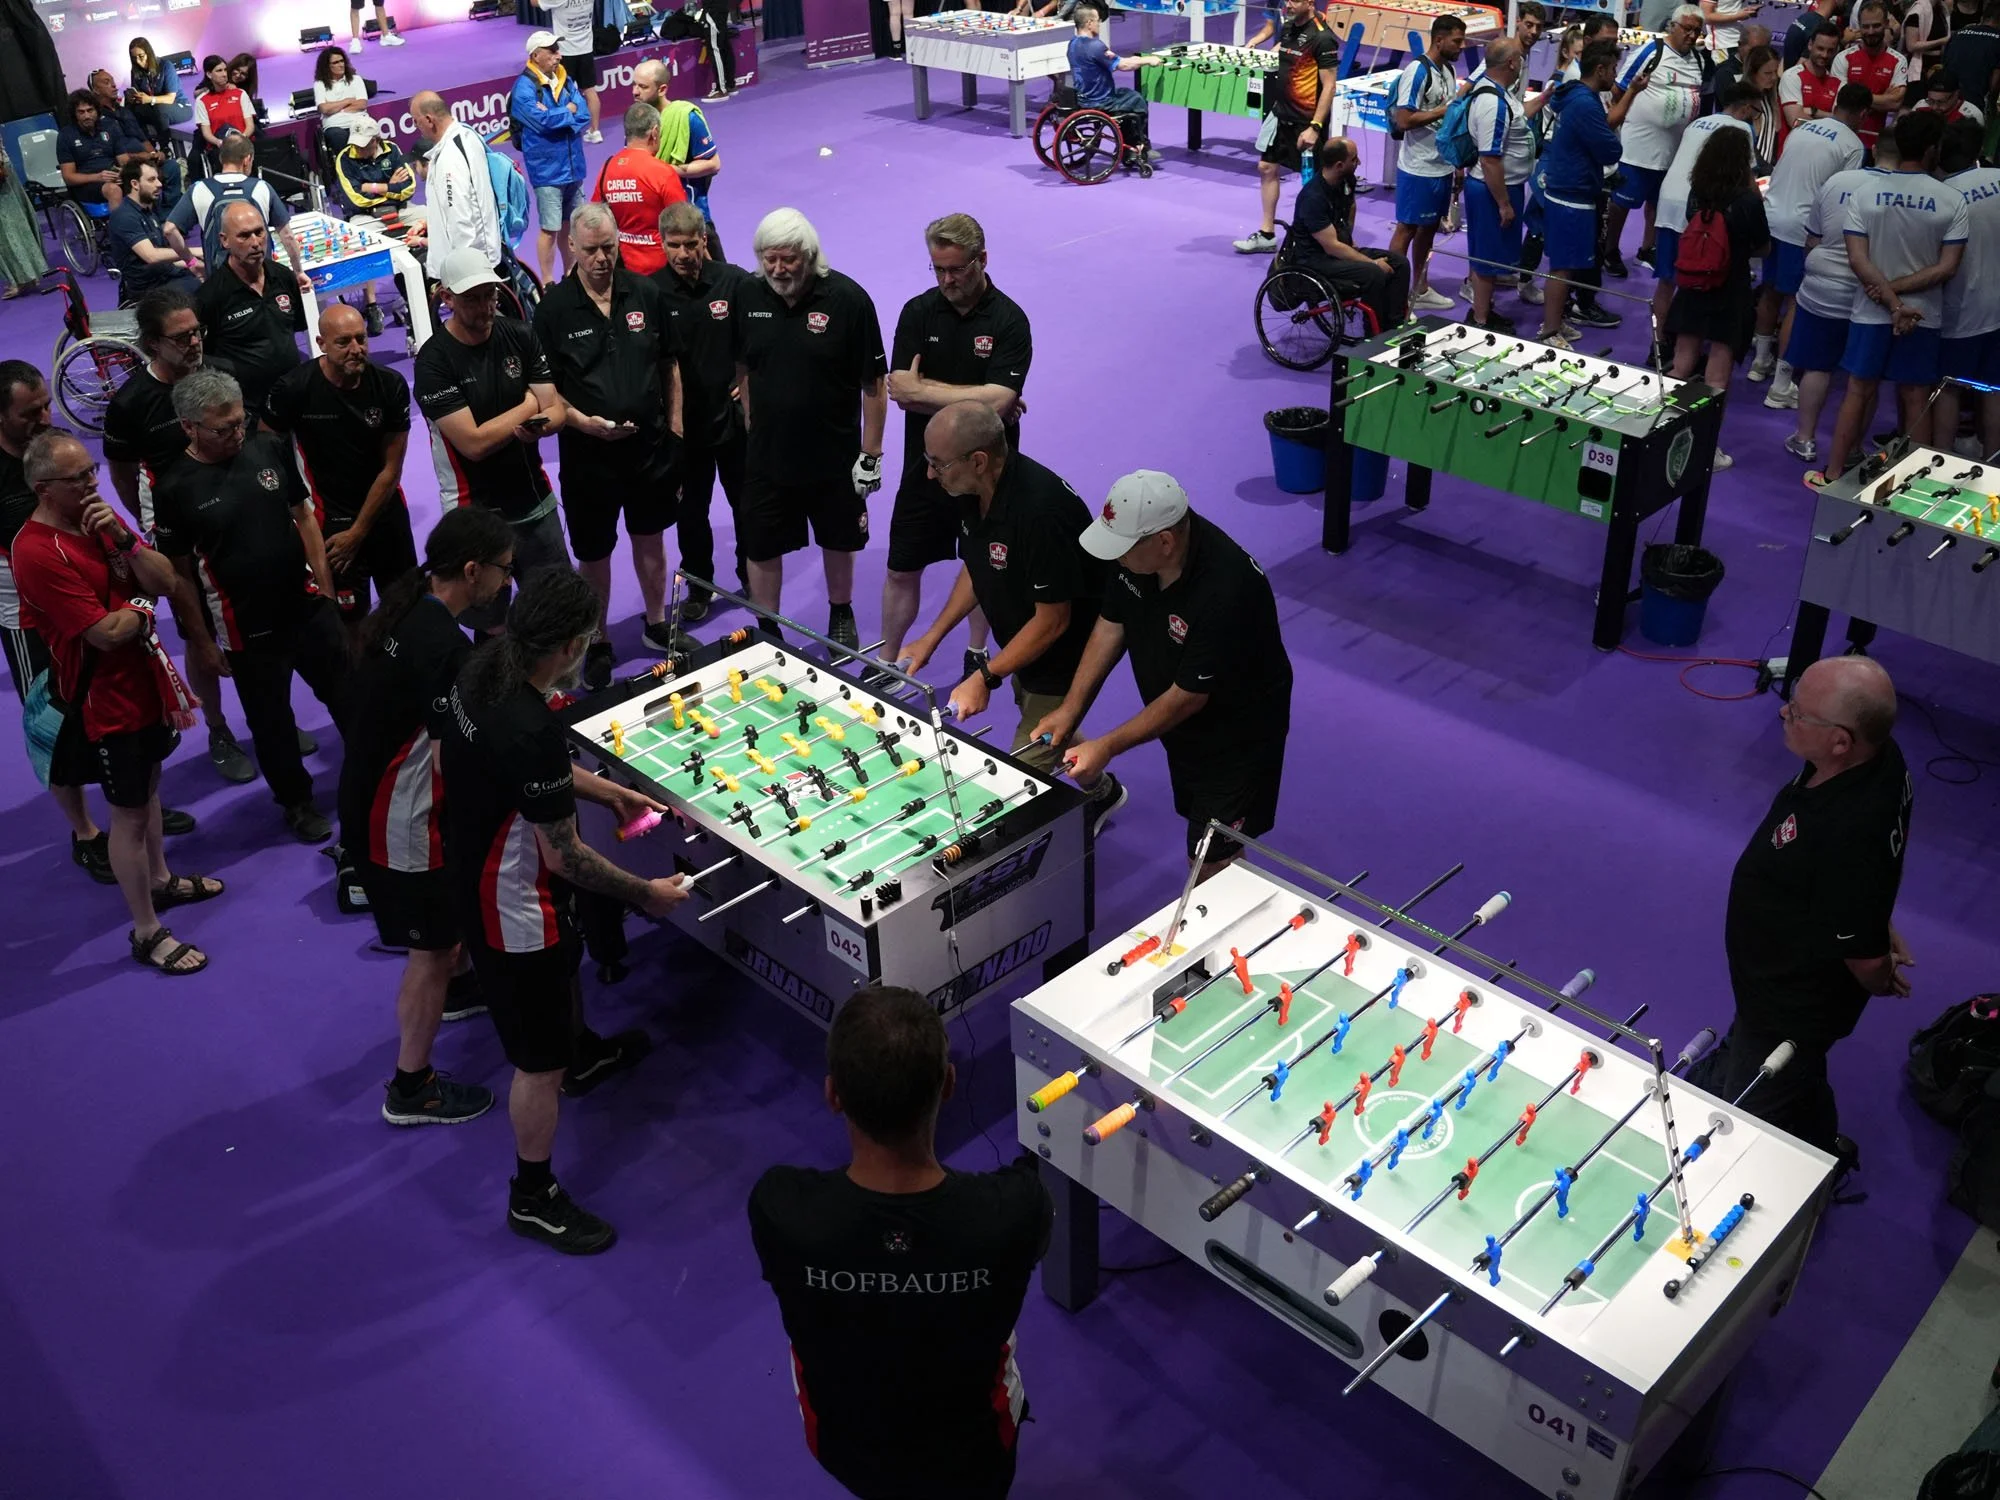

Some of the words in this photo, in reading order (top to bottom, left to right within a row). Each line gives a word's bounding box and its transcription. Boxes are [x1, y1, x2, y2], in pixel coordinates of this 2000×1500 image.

[607, 180, 637, 191] CARLOS
[605, 192, 643, 203] CLEMENTE
[618, 231, 657, 246] ORTUGAL
[574, 328, 594, 338] TENCH
[1588, 449, 1615, 467] 039
[830, 930, 863, 963] 042
[805, 1266, 992, 1294] HOFBAUER
[1528, 1403, 1576, 1443] 041
